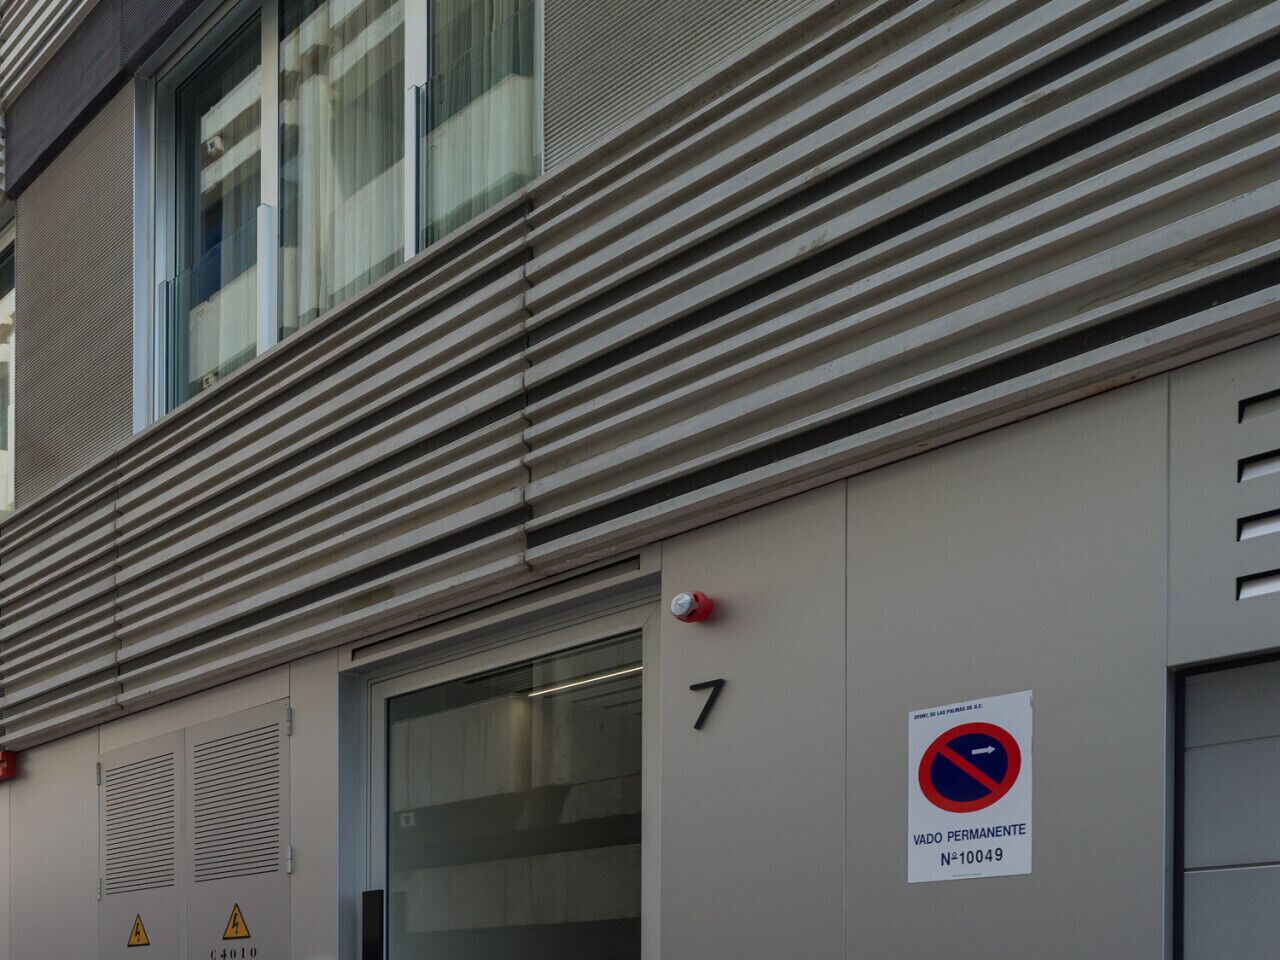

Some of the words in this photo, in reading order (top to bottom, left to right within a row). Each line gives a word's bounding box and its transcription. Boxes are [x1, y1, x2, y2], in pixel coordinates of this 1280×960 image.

[689, 678, 726, 730] 7
[913, 832, 943, 846] VADO
[947, 823, 1026, 842] PERMANENTE
[210, 947, 257, 960] C4010
